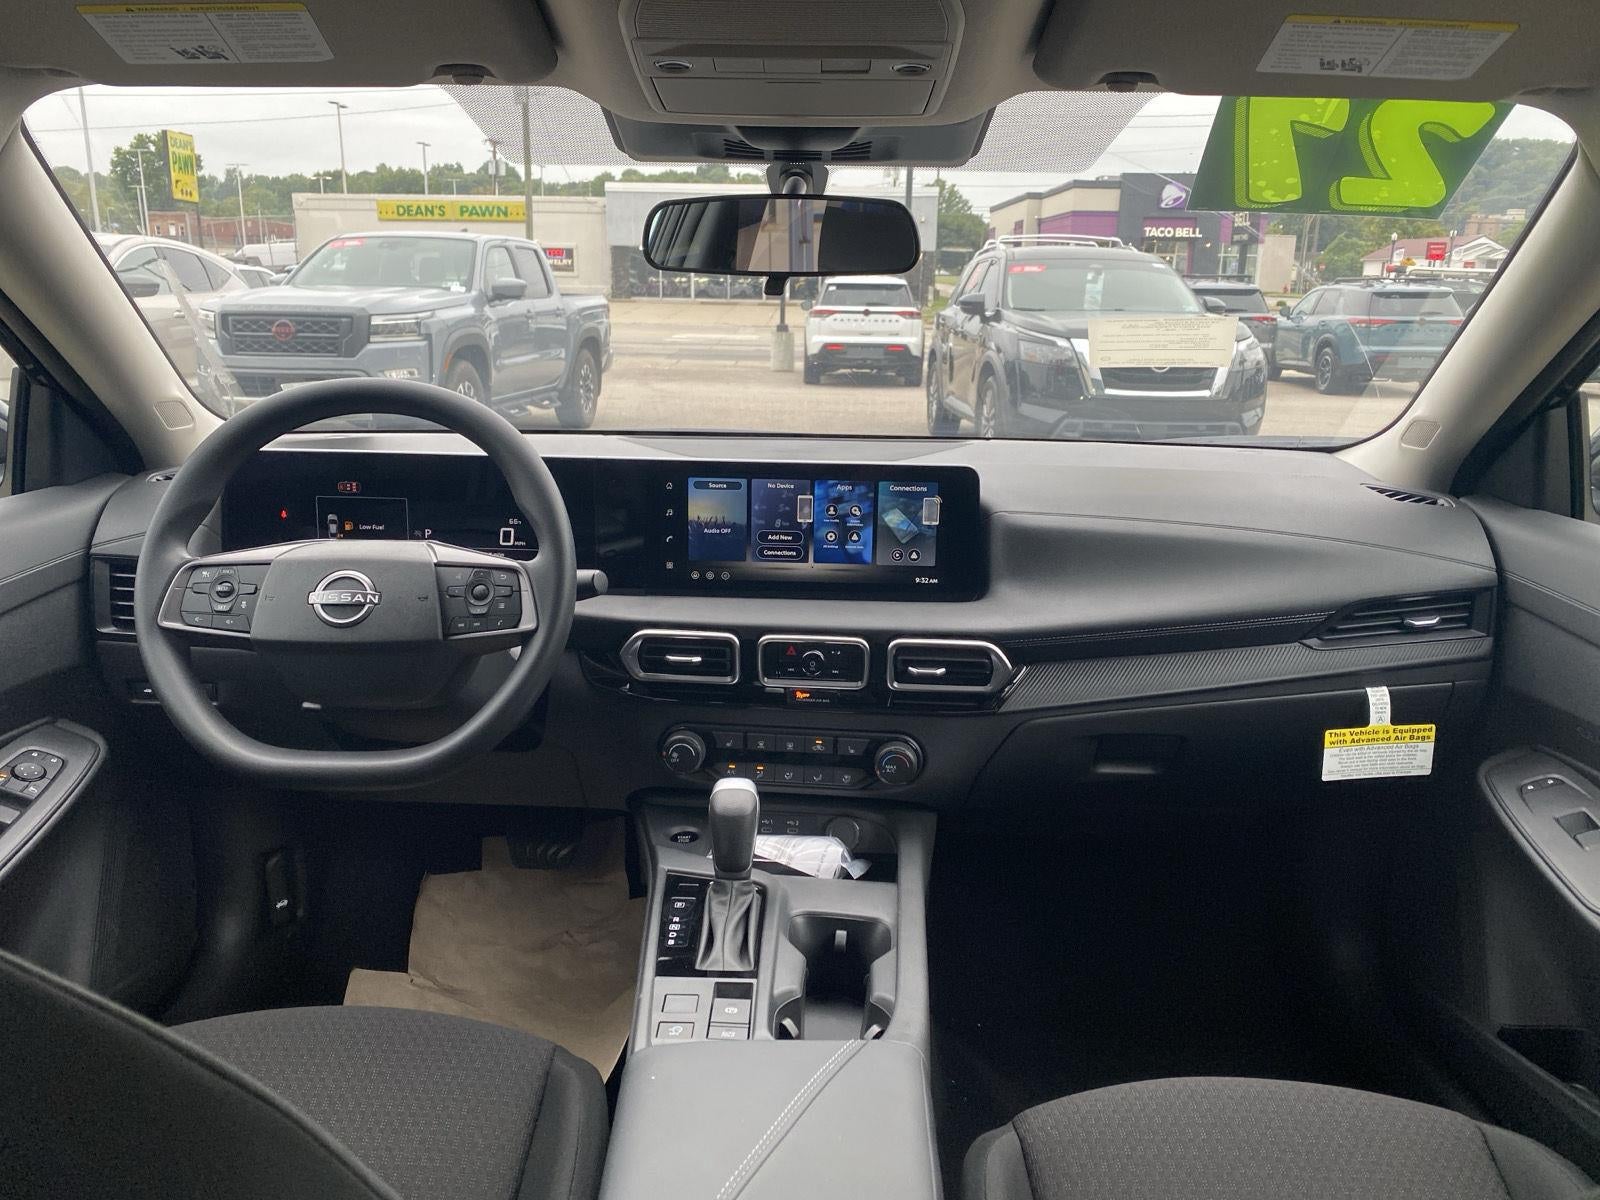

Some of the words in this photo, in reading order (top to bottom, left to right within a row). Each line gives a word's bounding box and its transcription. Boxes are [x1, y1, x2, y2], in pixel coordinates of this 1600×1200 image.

[172, 151, 195, 176] PAWN
[396, 204, 446, 217] DEAN'S
[459, 205, 509, 218] PAWN
[1144, 227, 1174, 237] TACO
[1175, 227, 1203, 238] BELL
[425, 529, 432, 538] P
[763, 549, 797, 557] Connections
[310, 593, 379, 603] NISSAN
[1349, 729, 1380, 737] Vehicle
[1393, 726, 1433, 734] Equipped
[1329, 738, 1347, 746] with
[1350, 735, 1391, 744] Advanced
[1409, 734, 1431, 742] Bags
